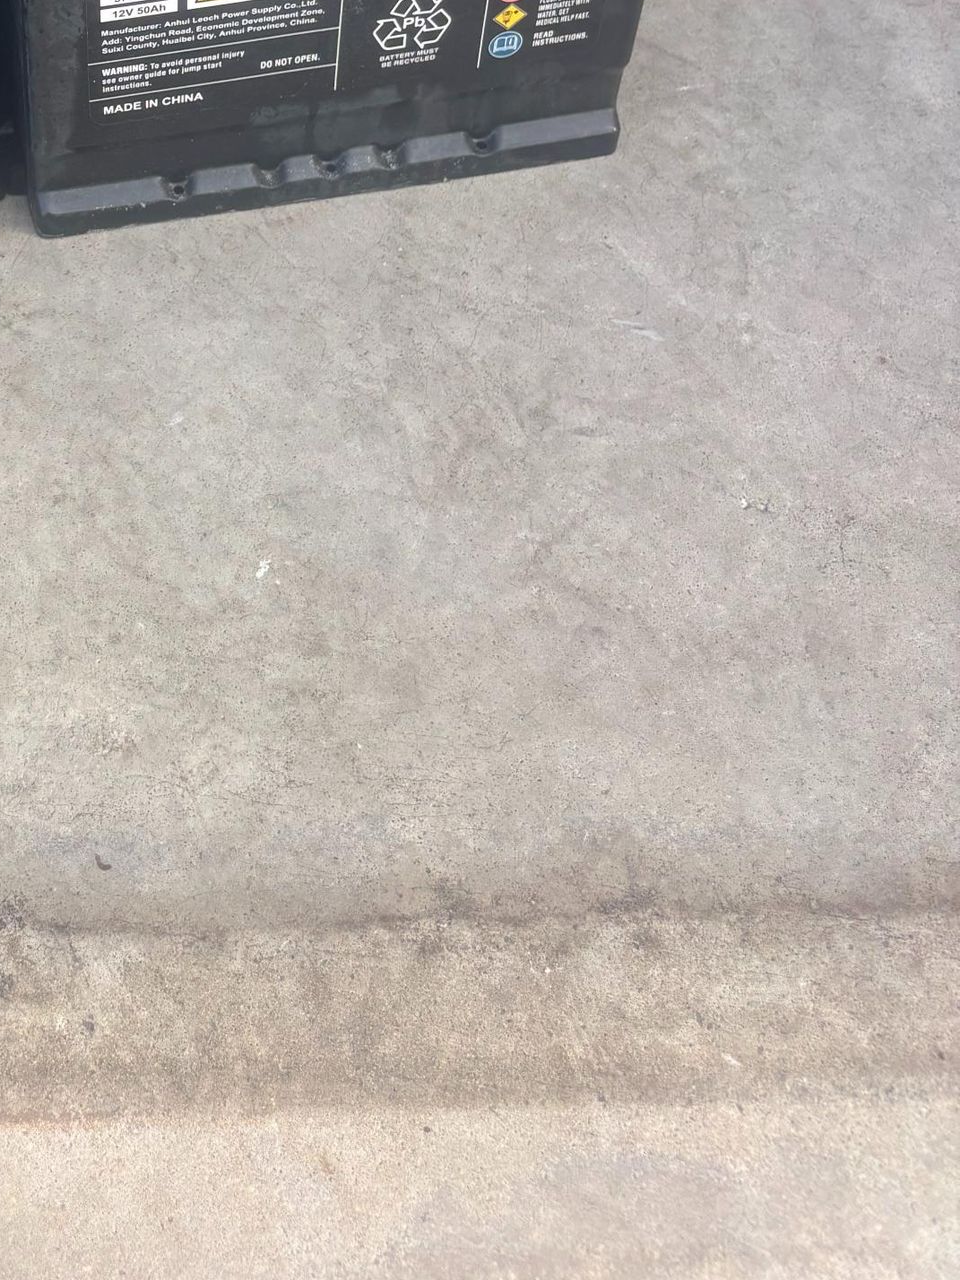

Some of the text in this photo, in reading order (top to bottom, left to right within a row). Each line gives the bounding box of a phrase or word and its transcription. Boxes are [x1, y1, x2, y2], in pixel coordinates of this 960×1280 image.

[112, 4, 166, 18] 12V 50Ah
[101, 23, 161, 37] Manufacturer:
[163, 17, 190, 28] Anhui
[192, 13, 220, 24] Leoch
[221, 9, 250, 20] Power
[251, 5, 282, 16] Supply
[101, 38, 122, 47] Add:
[124, 31, 167, 44] Yingchun
[195, 20, 240, 32] Economic
[241, 10, 299, 26] Development
[403, 16, 426, 29] Pb
[101, 45, 123, 55] Suixi
[218, 27, 245, 37] Anhui
[533, 30, 554, 40] READ
[260, 53, 320, 70] DO NOT OPEN.
[379, 47, 439, 62] BATTERY MUST
[381, 54, 436, 68] BE RECYCLED
[101, 50, 245, 77] WARNING: To avoid personal injury
[101, 61, 222, 85] see owner guide for jump start
[102, 80, 152, 93] instructions.
[103, 92, 204, 115] MADE IN CHINA
